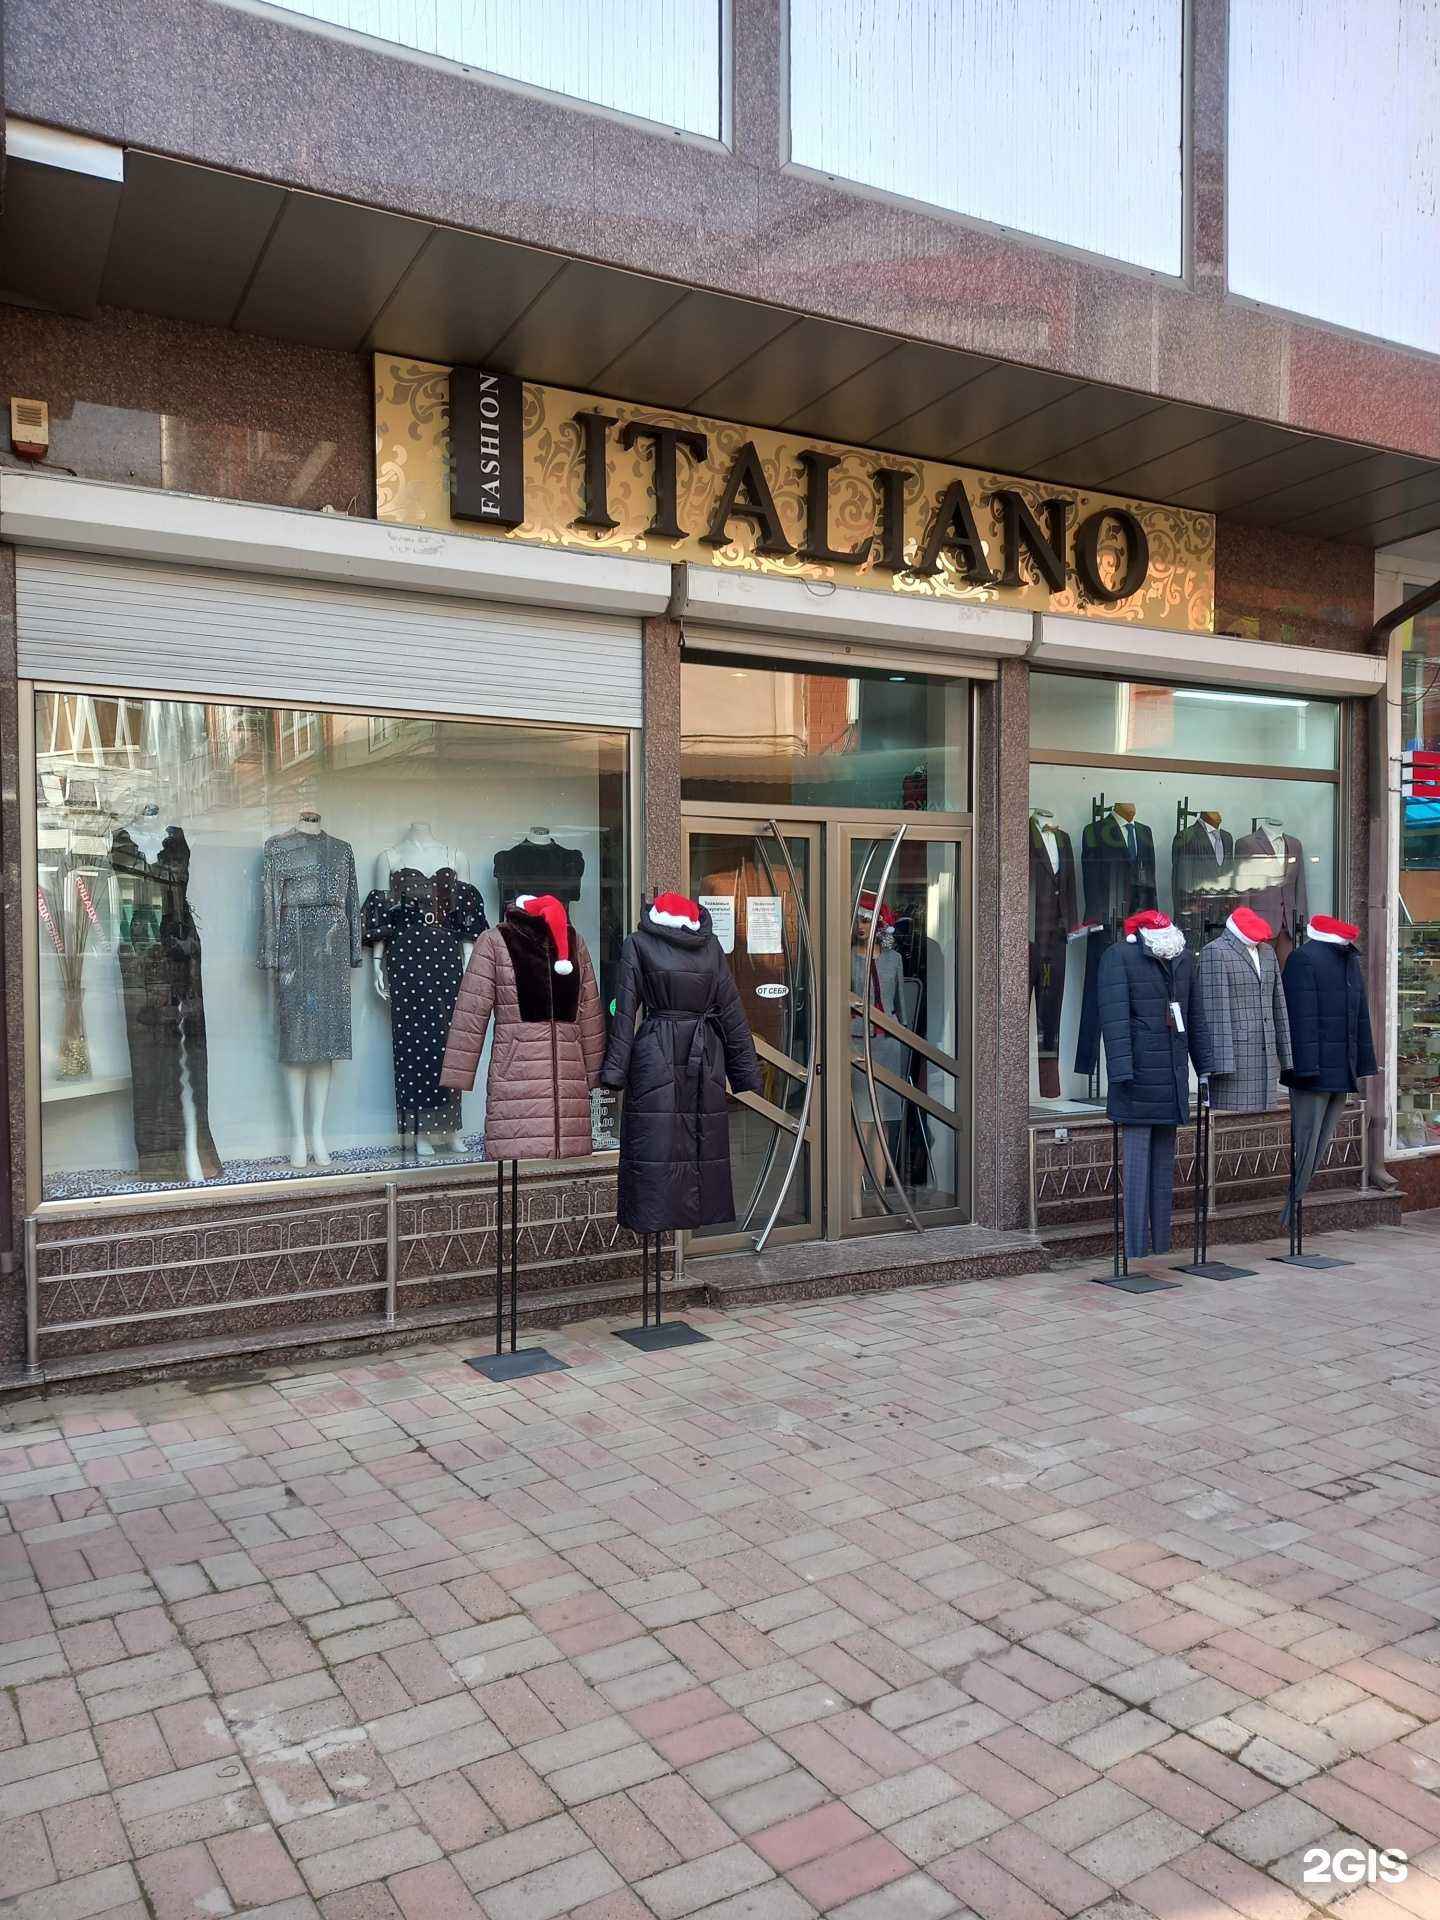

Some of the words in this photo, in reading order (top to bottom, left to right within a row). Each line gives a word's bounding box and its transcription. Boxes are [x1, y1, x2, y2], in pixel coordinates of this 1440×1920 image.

[480, 372, 501, 517] FASHION
[572, 411, 1150, 600] ITALIANO
[758, 987, 767, 995] ОТ
[769, 987, 787, 995] СЕБЯ
